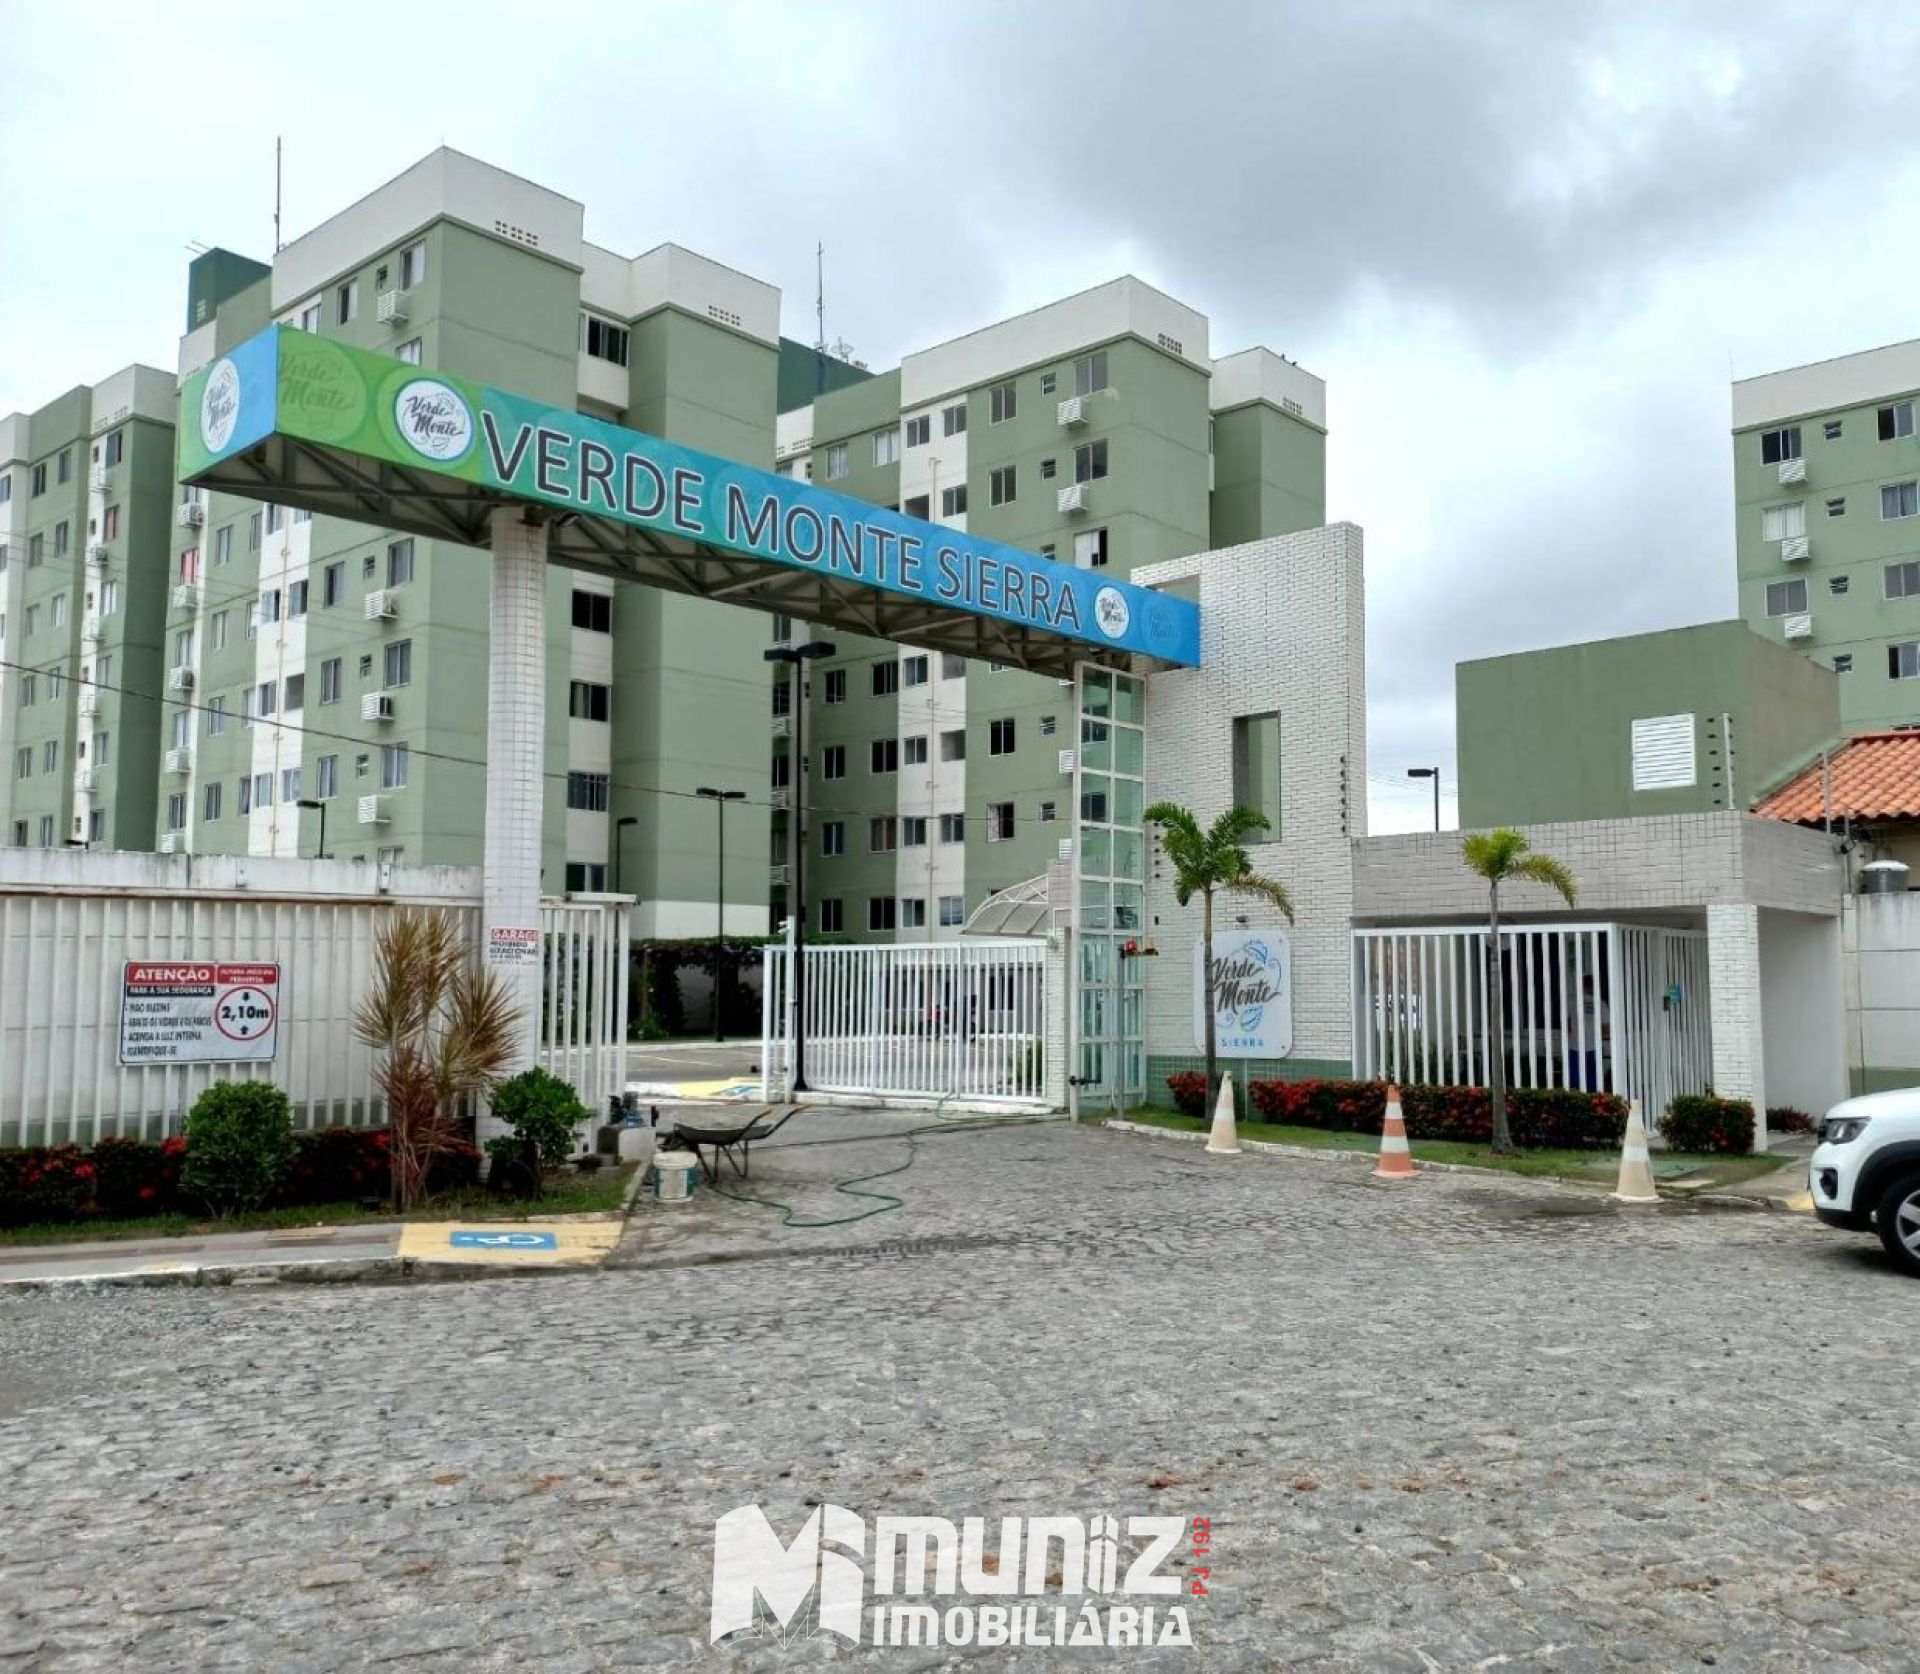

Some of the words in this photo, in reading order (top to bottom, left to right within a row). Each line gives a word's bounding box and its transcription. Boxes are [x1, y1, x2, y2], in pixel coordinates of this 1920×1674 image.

[405, 395, 455, 416] Verde
[410, 412, 465, 438] Monte
[480, 409, 704, 533] VERDE
[726, 483, 924, 591] MONTE
[936, 546, 1082, 631] SIERRA
[134, 966, 210, 983] ATENÇÃO
[1210, 956, 1264, 984] Verde
[1213, 979, 1282, 1015] Monte
[221, 1005, 269, 1021] 2,10m
